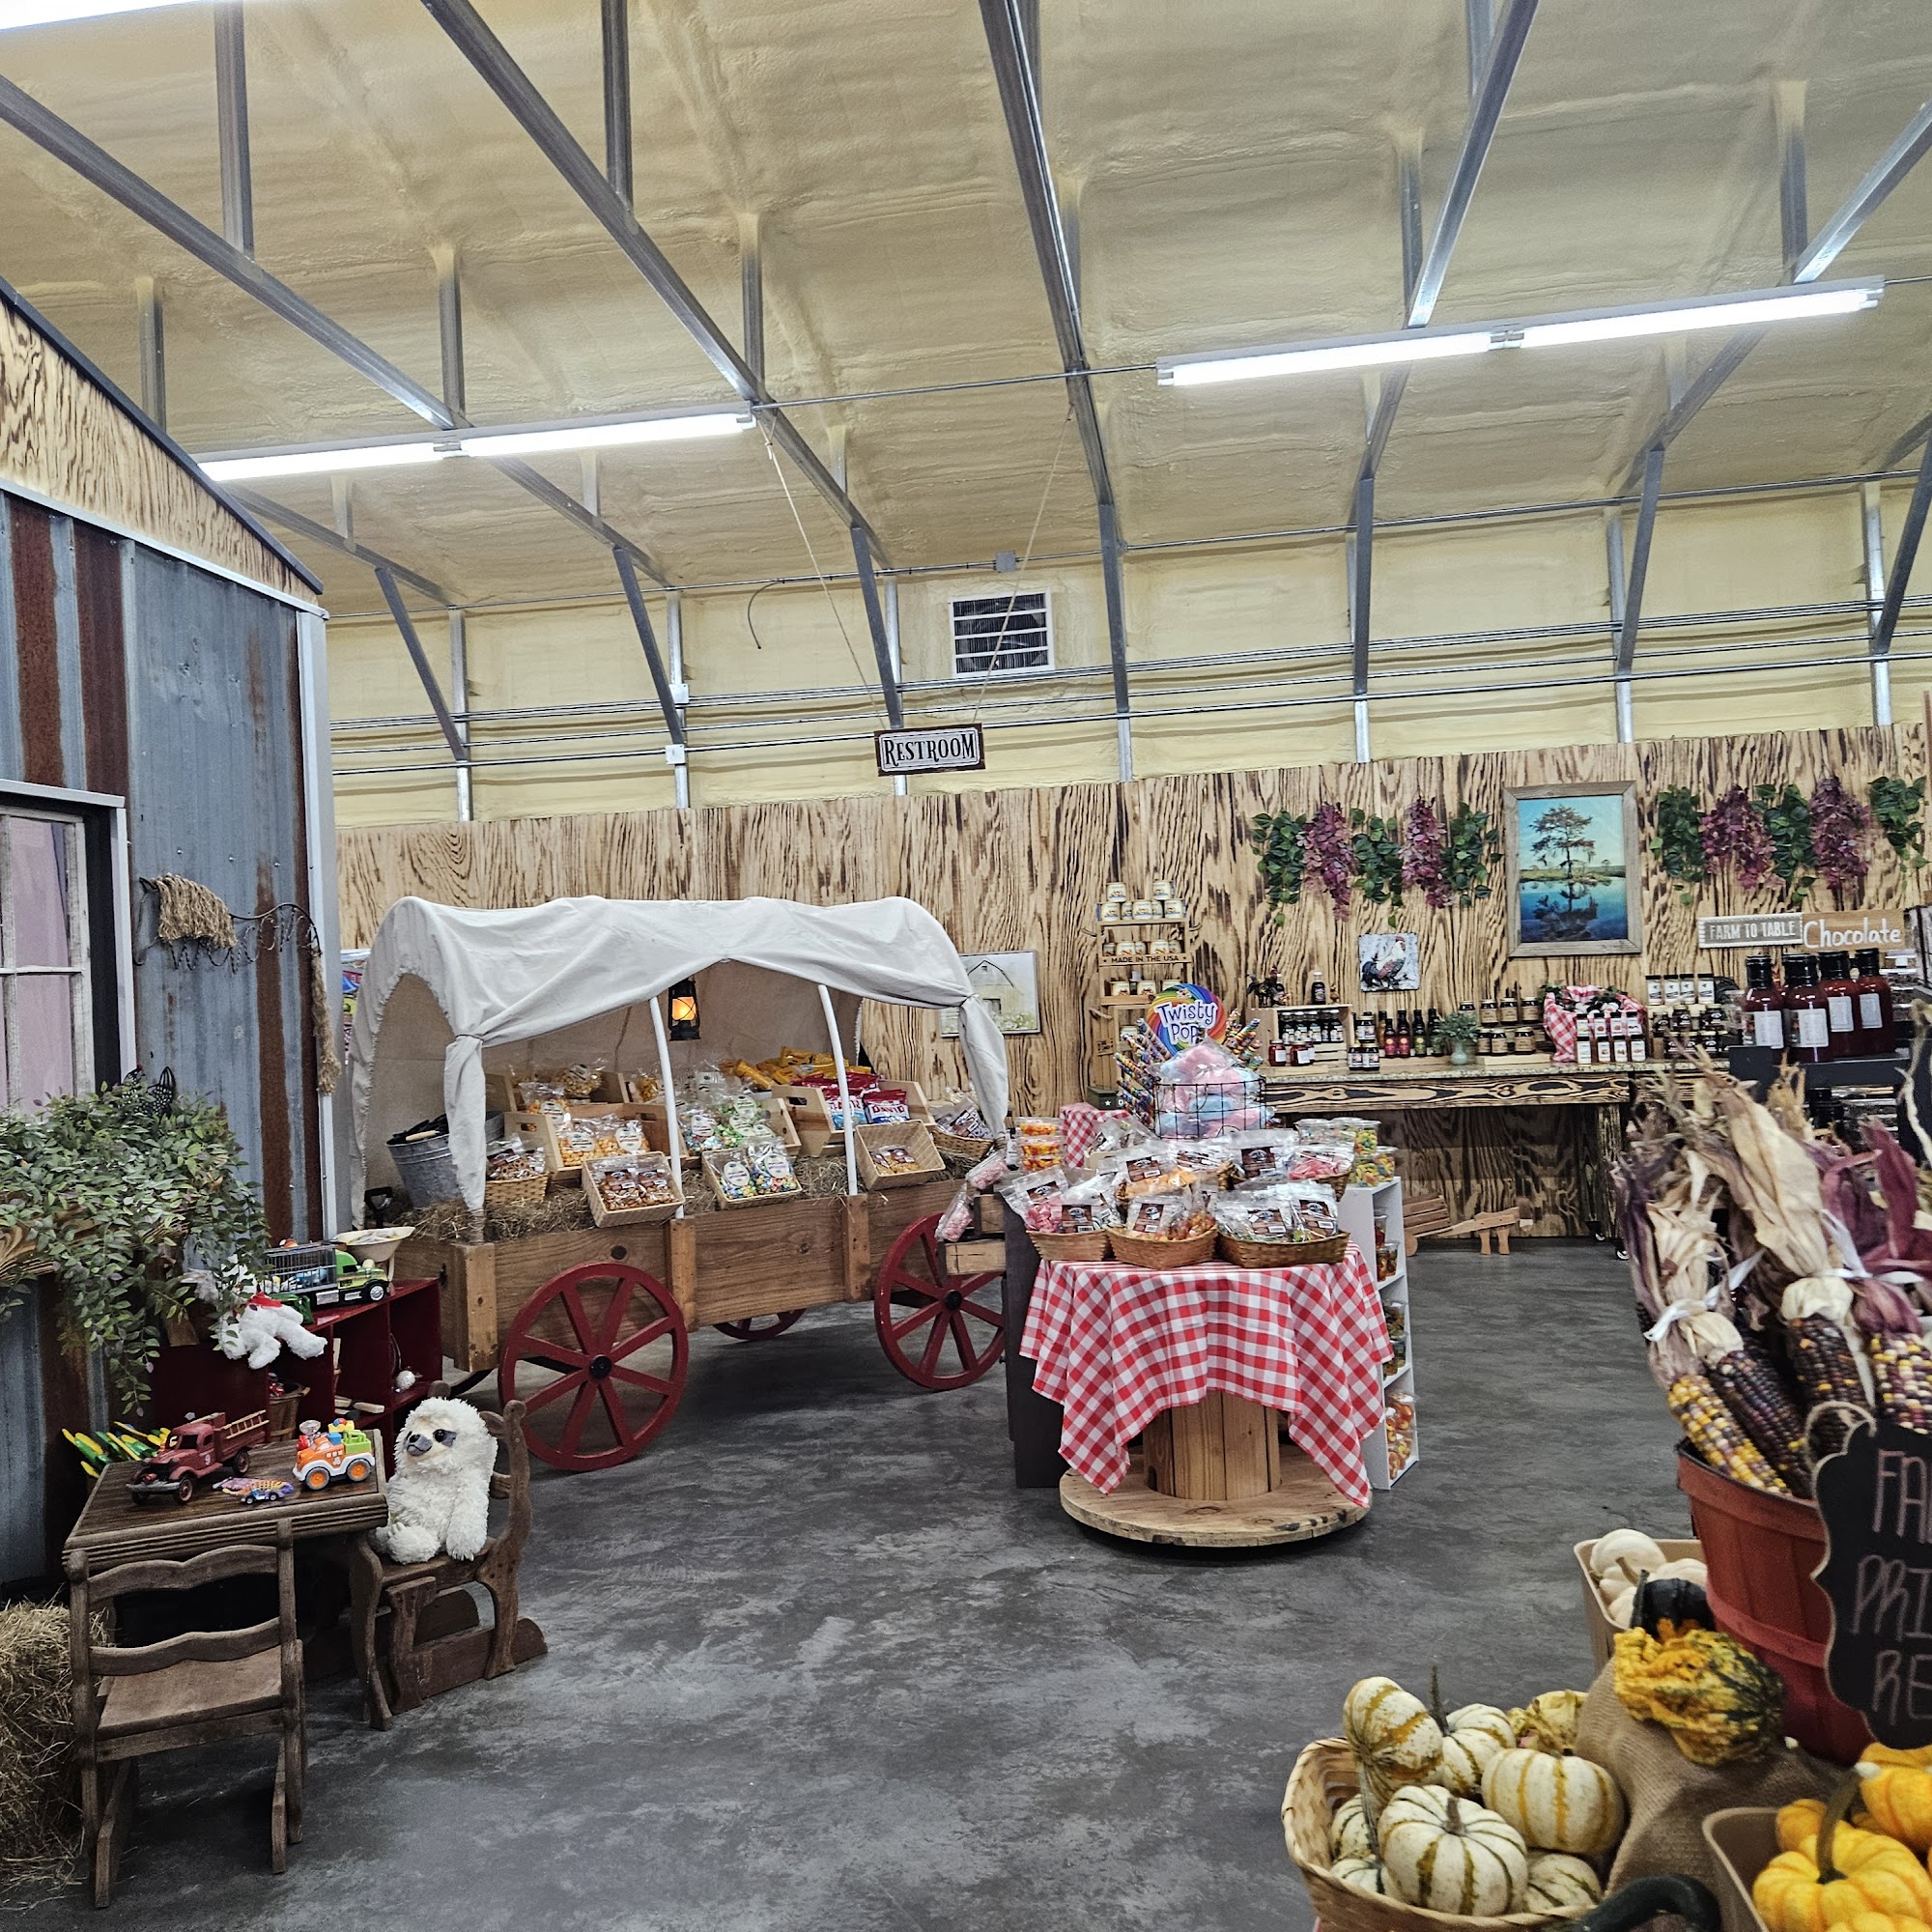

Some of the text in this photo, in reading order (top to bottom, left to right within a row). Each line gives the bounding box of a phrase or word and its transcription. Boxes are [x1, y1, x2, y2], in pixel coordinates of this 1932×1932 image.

[883, 733, 976, 767] RESTROOM
[1709, 920, 1797, 941] FARM TO TABLE
[1803, 917, 1901, 950] Chocolate
[1156, 1001, 1216, 1026] Twisty
[871, 1104, 905, 1114] DAVID
